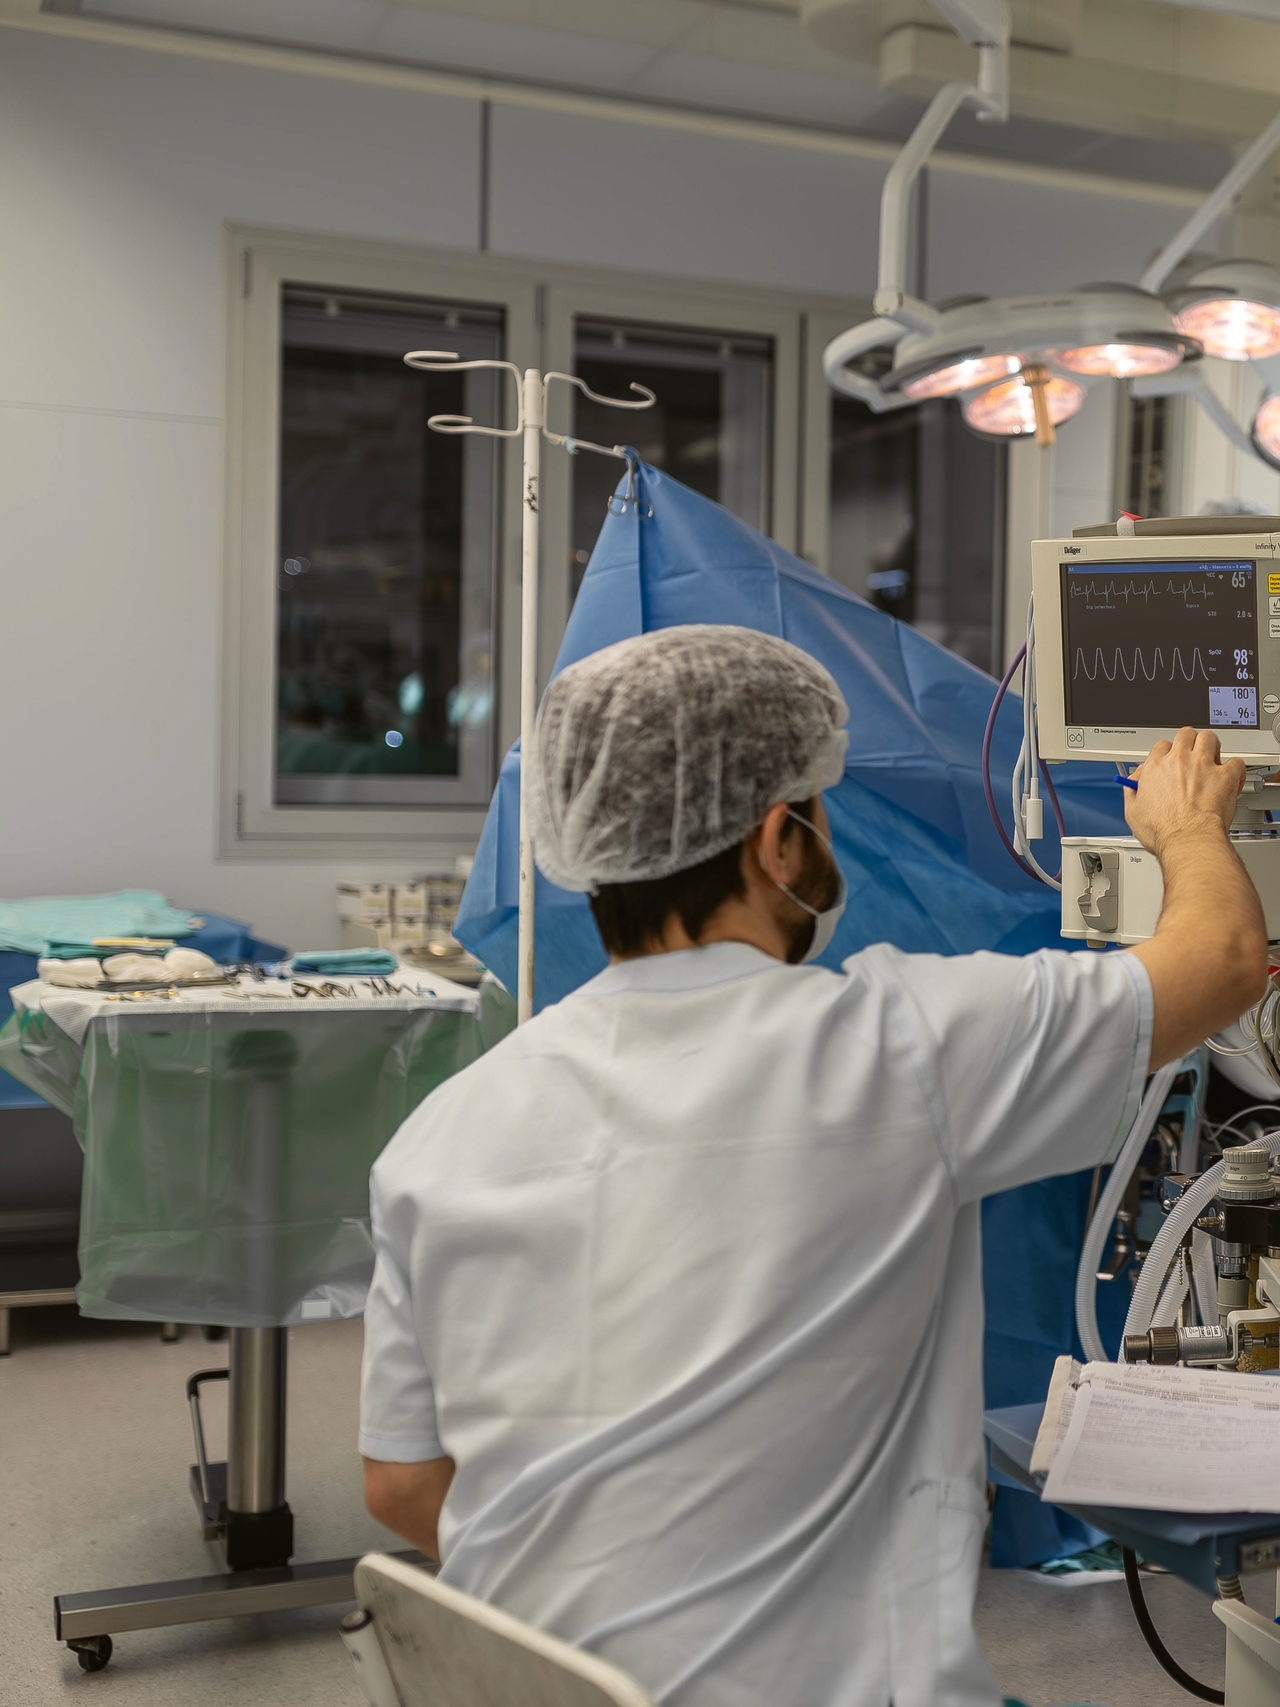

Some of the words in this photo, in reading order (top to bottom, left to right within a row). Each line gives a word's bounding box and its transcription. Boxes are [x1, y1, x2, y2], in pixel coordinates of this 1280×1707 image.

[1064, 546, 1082, 555] Dräger
[1255, 543, 1277, 552] Infinity
[1231, 571, 1246, 588] 65
[1237, 610, 1246, 618] 2.0
[1233, 648, 1248, 666] 98
[1236, 667, 1249, 680] 66
[1232, 688, 1249, 700] 180
[1213, 709, 1223, 717] 136
[1237, 707, 1249, 719] 96
